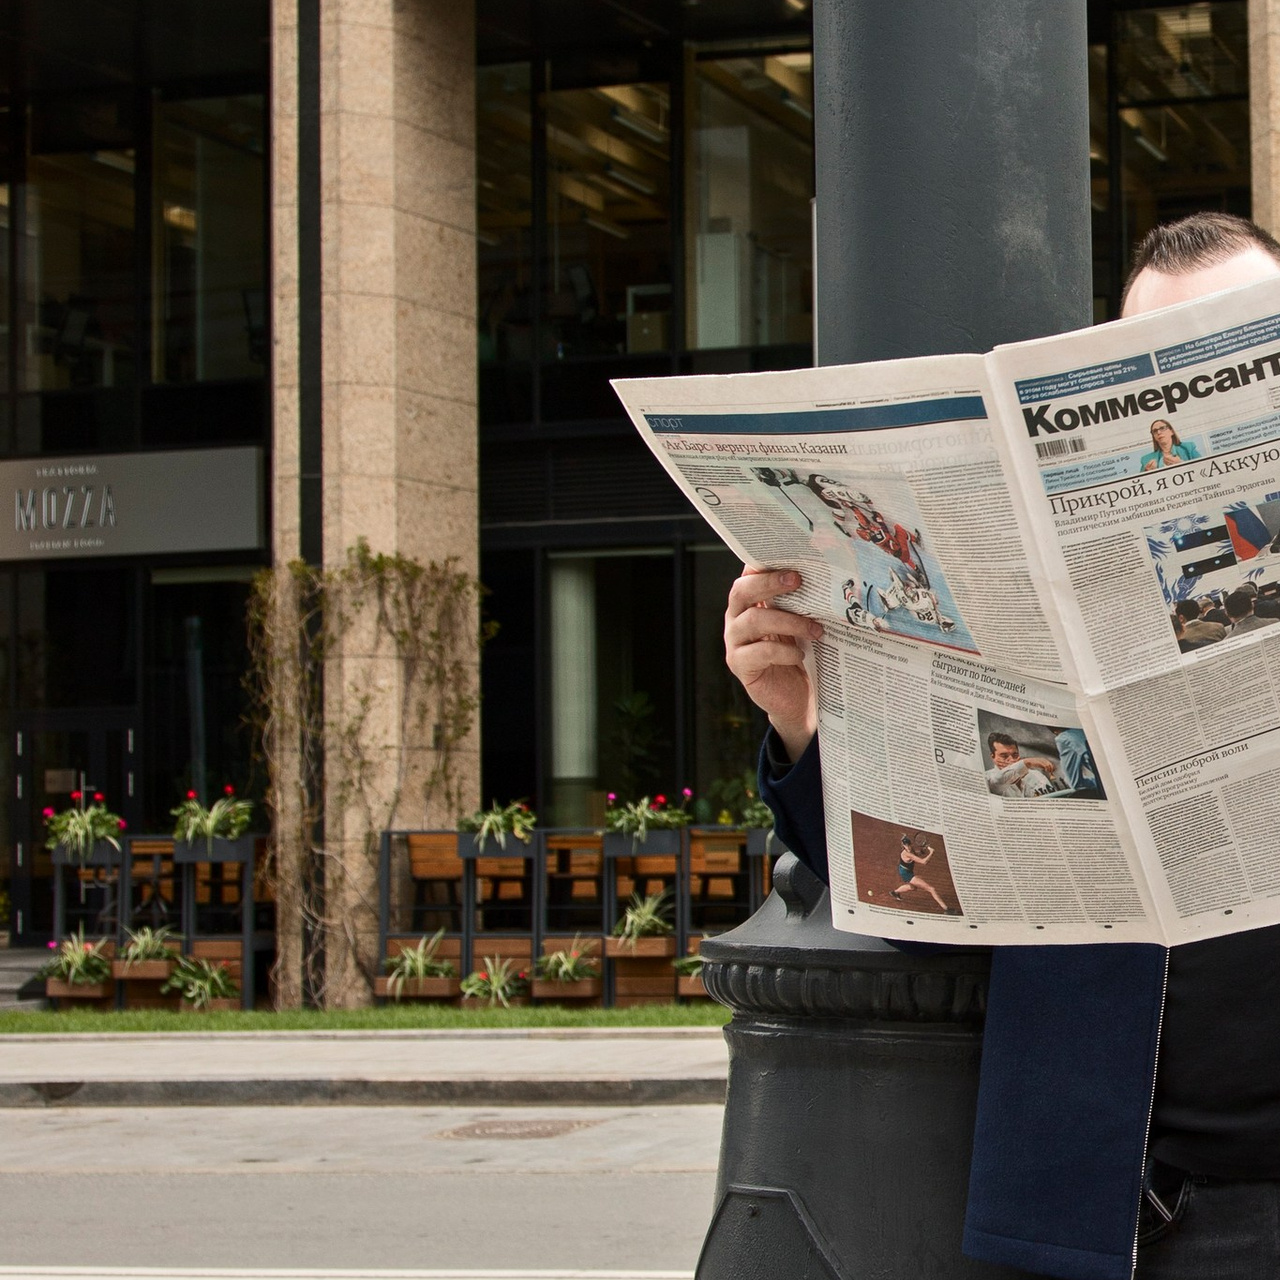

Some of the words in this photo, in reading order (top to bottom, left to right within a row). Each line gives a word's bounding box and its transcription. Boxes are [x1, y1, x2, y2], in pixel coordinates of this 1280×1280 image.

[1158, 356, 1168, 364] об
[1168, 347, 1204, 362] уклонении
[1213, 337, 1237, 349] уплаты
[1238, 328, 1265, 340] налогов
[1194, 335, 1221, 347] блогера
[1222, 328, 1242, 338] Елену
[1171, 351, 1214, 366] легализации
[1215, 340, 1249, 354] денежных
[1249, 331, 1277, 343] средств
[1024, 386, 1041, 394] этом
[1057, 379, 1077, 387] могут
[1077, 371, 1112, 383] снизиться
[1121, 365, 1137, 373] 21%
[1039, 384, 1079, 397] ослабления
[1079, 379, 1104, 389] спроса
[648, 417, 683, 430] спорт
[1236, 415, 1278, 431] Командующий
[661, 440, 681, 450] «Ак
[681, 440, 713, 453] Барс»
[715, 443, 758, 455] вернул
[758, 442, 799, 455] финал
[799, 442, 848, 454] Казани
[1219, 433, 1261, 448] Черноморский
[1082, 462, 1101, 470] Посол
[1059, 473, 1080, 481] Трейси
[1050, 479, 1152, 515] Прикрой,
[1155, 477, 1168, 490] я
[1171, 469, 1194, 485] от
[15, 485, 117, 532] MOZZA
[1054, 513, 1098, 527] Владимир
[1098, 506, 1127, 518] Путин
[1127, 497, 1164, 511] проявил
[1165, 482, 1221, 501] соответствие
[1057, 518, 1119, 536] политическим
[1120, 506, 1165, 522] амбициям
[1165, 496, 1203, 510] Реджепа
[1202, 487, 1235, 500] Тайипа
[1235, 477, 1275, 492] Эрдогана
[932, 659, 967, 677] сыграют
[969, 669, 980, 680] по
[981, 674, 1026, 694] последней
[934, 748, 946, 764] В
[1135, 767, 1177, 788] Пенсии
[1179, 751, 1219, 772] доброй
[1220, 742, 1248, 757] воли
[1161, 777, 1197, 793] программу
